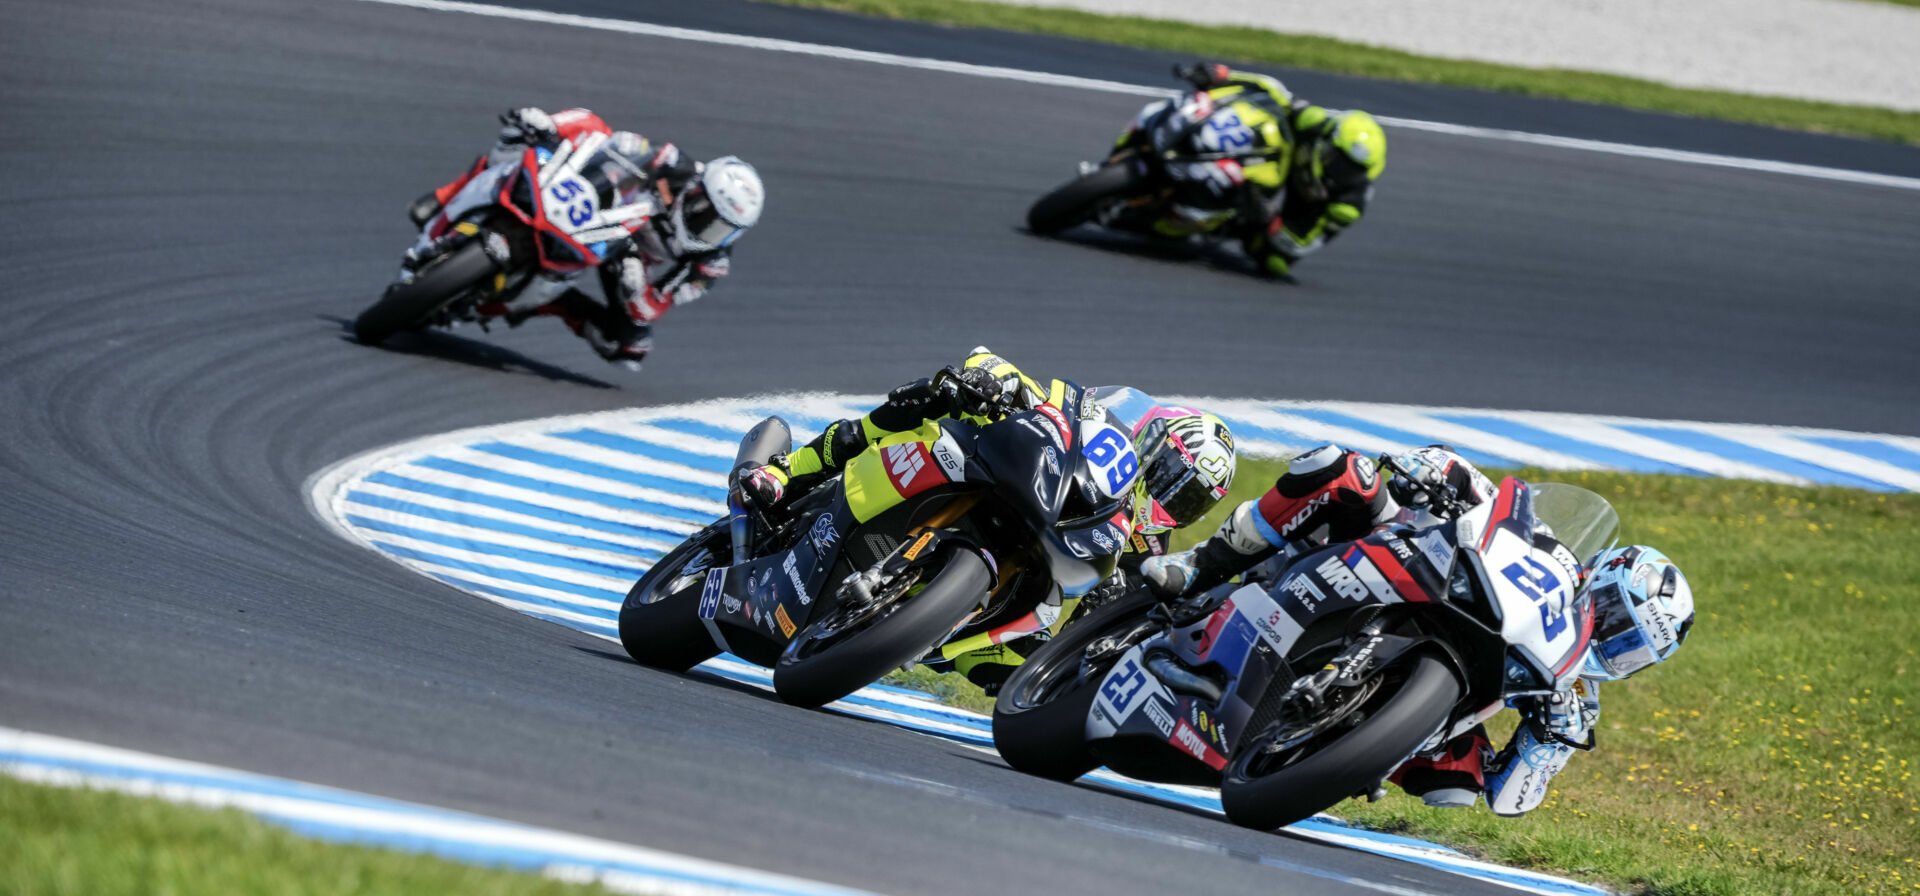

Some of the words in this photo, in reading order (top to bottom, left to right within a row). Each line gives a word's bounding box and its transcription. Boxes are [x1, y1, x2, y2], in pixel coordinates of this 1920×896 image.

[1208, 113, 1251, 151] 32
[552, 178, 594, 228] 53
[936, 445, 958, 470] 765
[1081, 427, 1138, 496] 69
[1316, 555, 1369, 602] WRP
[1500, 555, 1568, 643] 23
[1647, 602, 1673, 645] SHARK
[1100, 659, 1147, 714] 23
[1143, 696, 1175, 738] PIRELLI
[1176, 723, 1207, 761] MOTUL
